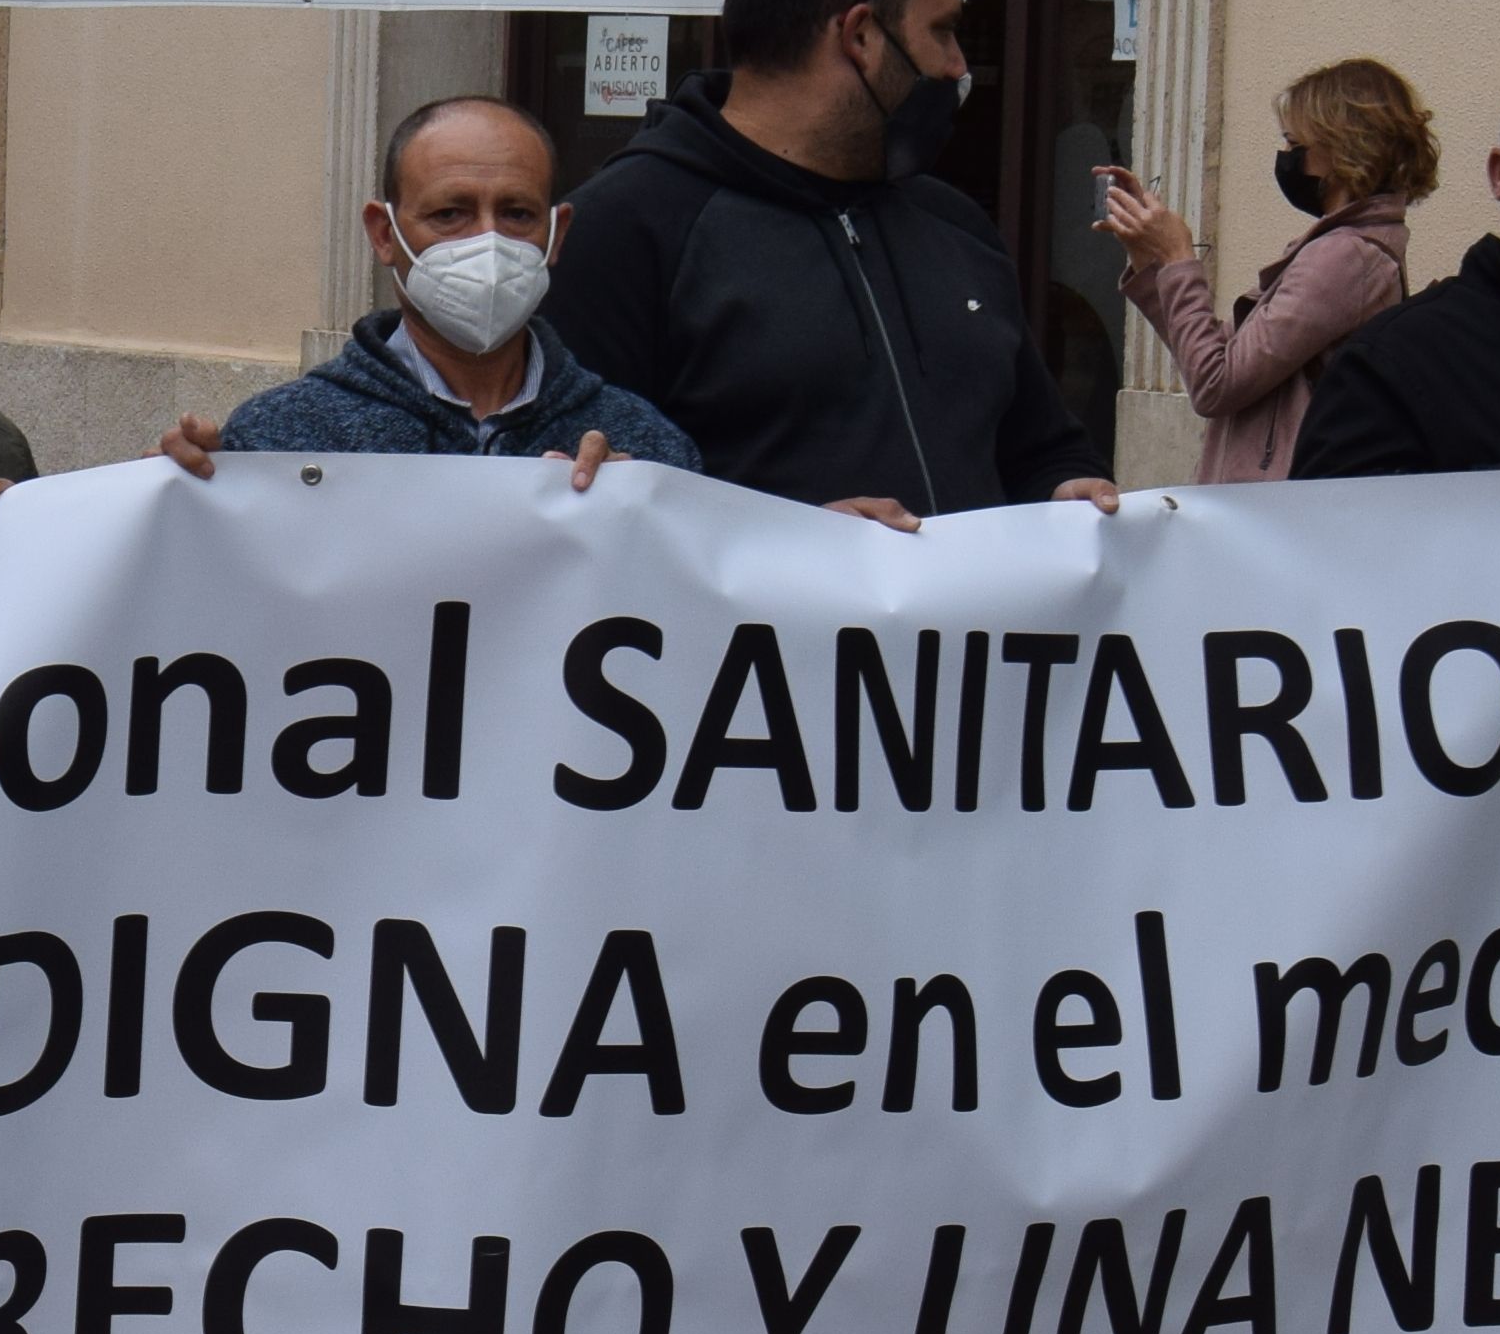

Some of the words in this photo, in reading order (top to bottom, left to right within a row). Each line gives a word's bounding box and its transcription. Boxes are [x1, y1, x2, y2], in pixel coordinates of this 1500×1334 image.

[593, 55, 660, 72] ABIERTO
[589, 80, 658, 97] INFUSIONES
[754, 967, 984, 1118] en
[1030, 907, 1182, 1111] el
